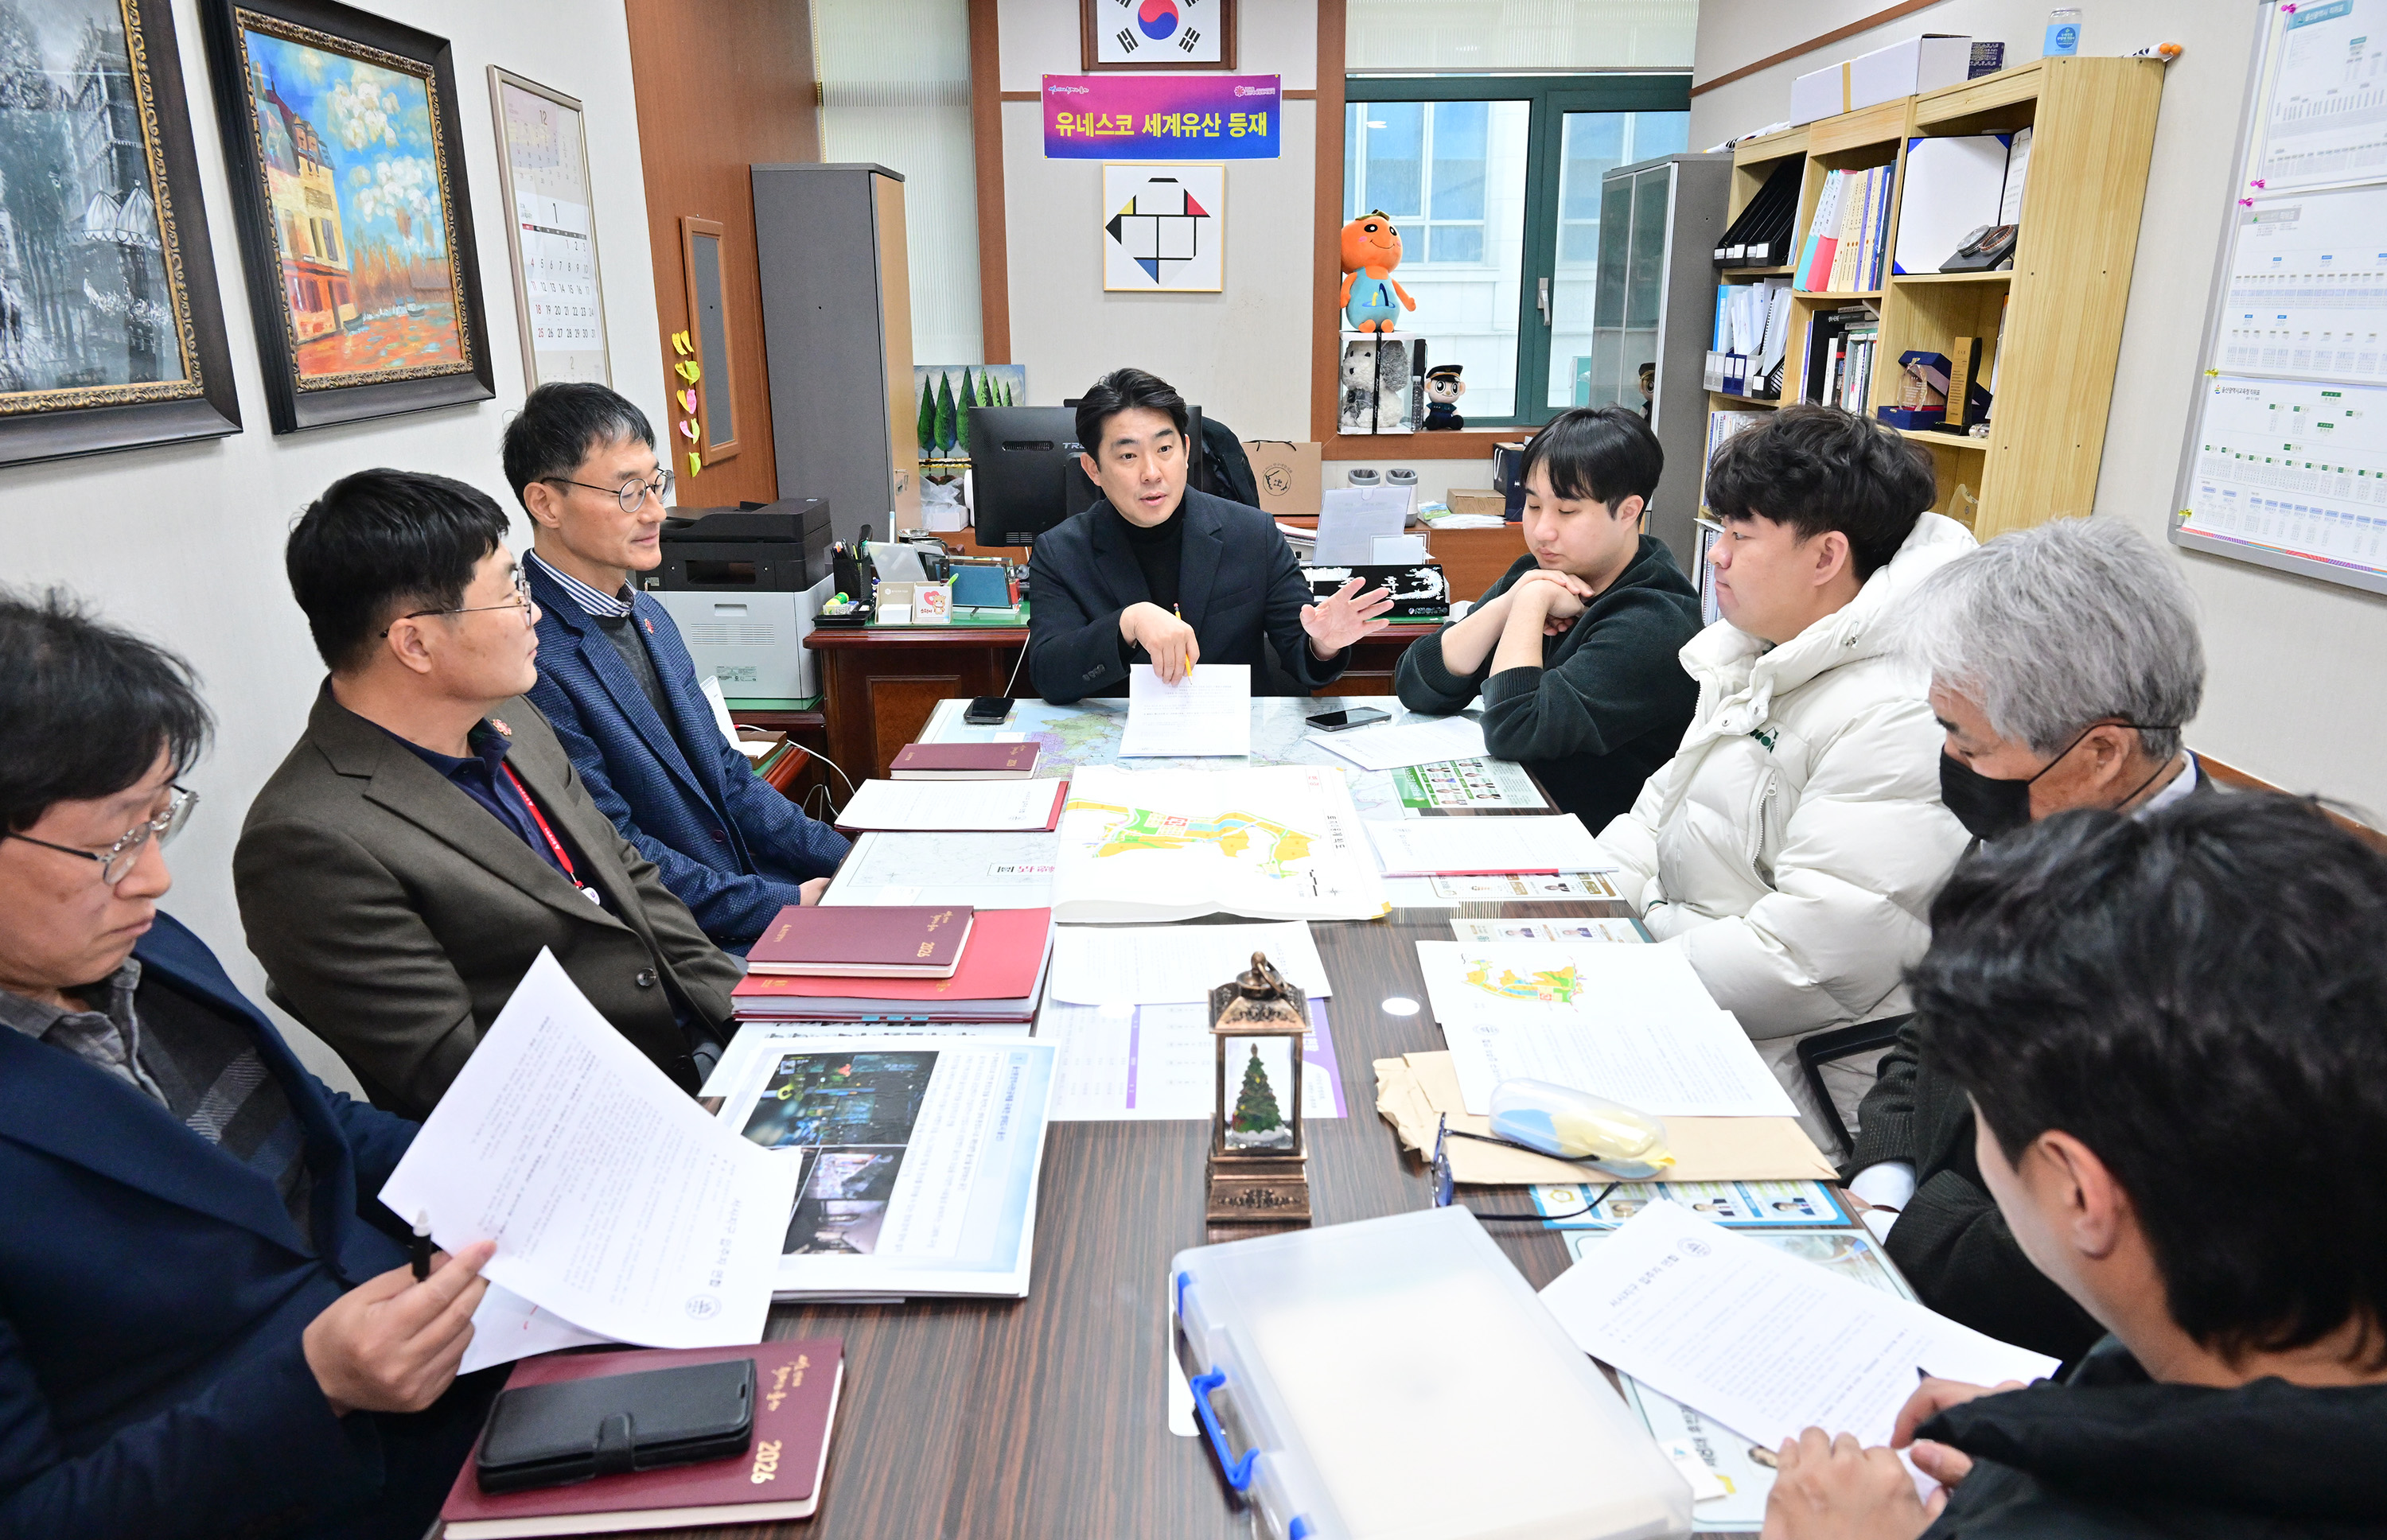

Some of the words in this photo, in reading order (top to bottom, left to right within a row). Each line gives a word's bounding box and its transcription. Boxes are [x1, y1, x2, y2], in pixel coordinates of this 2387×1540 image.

[539, 110, 547, 126] 12
[1055, 111, 1135, 137] 유네스코
[1142, 112, 1221, 138] 세계유산
[1228, 111, 1267, 138] 등재
[552, 202, 559, 224] 1
[583, 264, 589, 274] 10
[531, 281, 537, 291] 11
[540, 282, 547, 292] 12
[549, 282, 556, 293] 13
[559, 283, 565, 293] 14
[567, 284, 574, 294] 15
[576, 285, 582, 294] 16
[535, 304, 542, 314] 18
[546, 305, 551, 315] 19
[555, 305, 561, 315] 20
[564, 306, 570, 316] 21
[572, 306, 578, 317] 22
[580, 307, 586, 317] 23
[589, 307, 594, 317] 24
[538, 328, 544, 338] 25
[547, 328, 554, 338] 26
[557, 328, 563, 338] 27
[566, 329, 572, 338] 28
[574, 329, 580, 338] 29
[582, 329, 589, 338] 30
[591, 329, 596, 338] 31
[570, 356, 574, 370] 2
[917, 942, 935, 958] 2026
[750, 1439, 783, 1484] 2026
